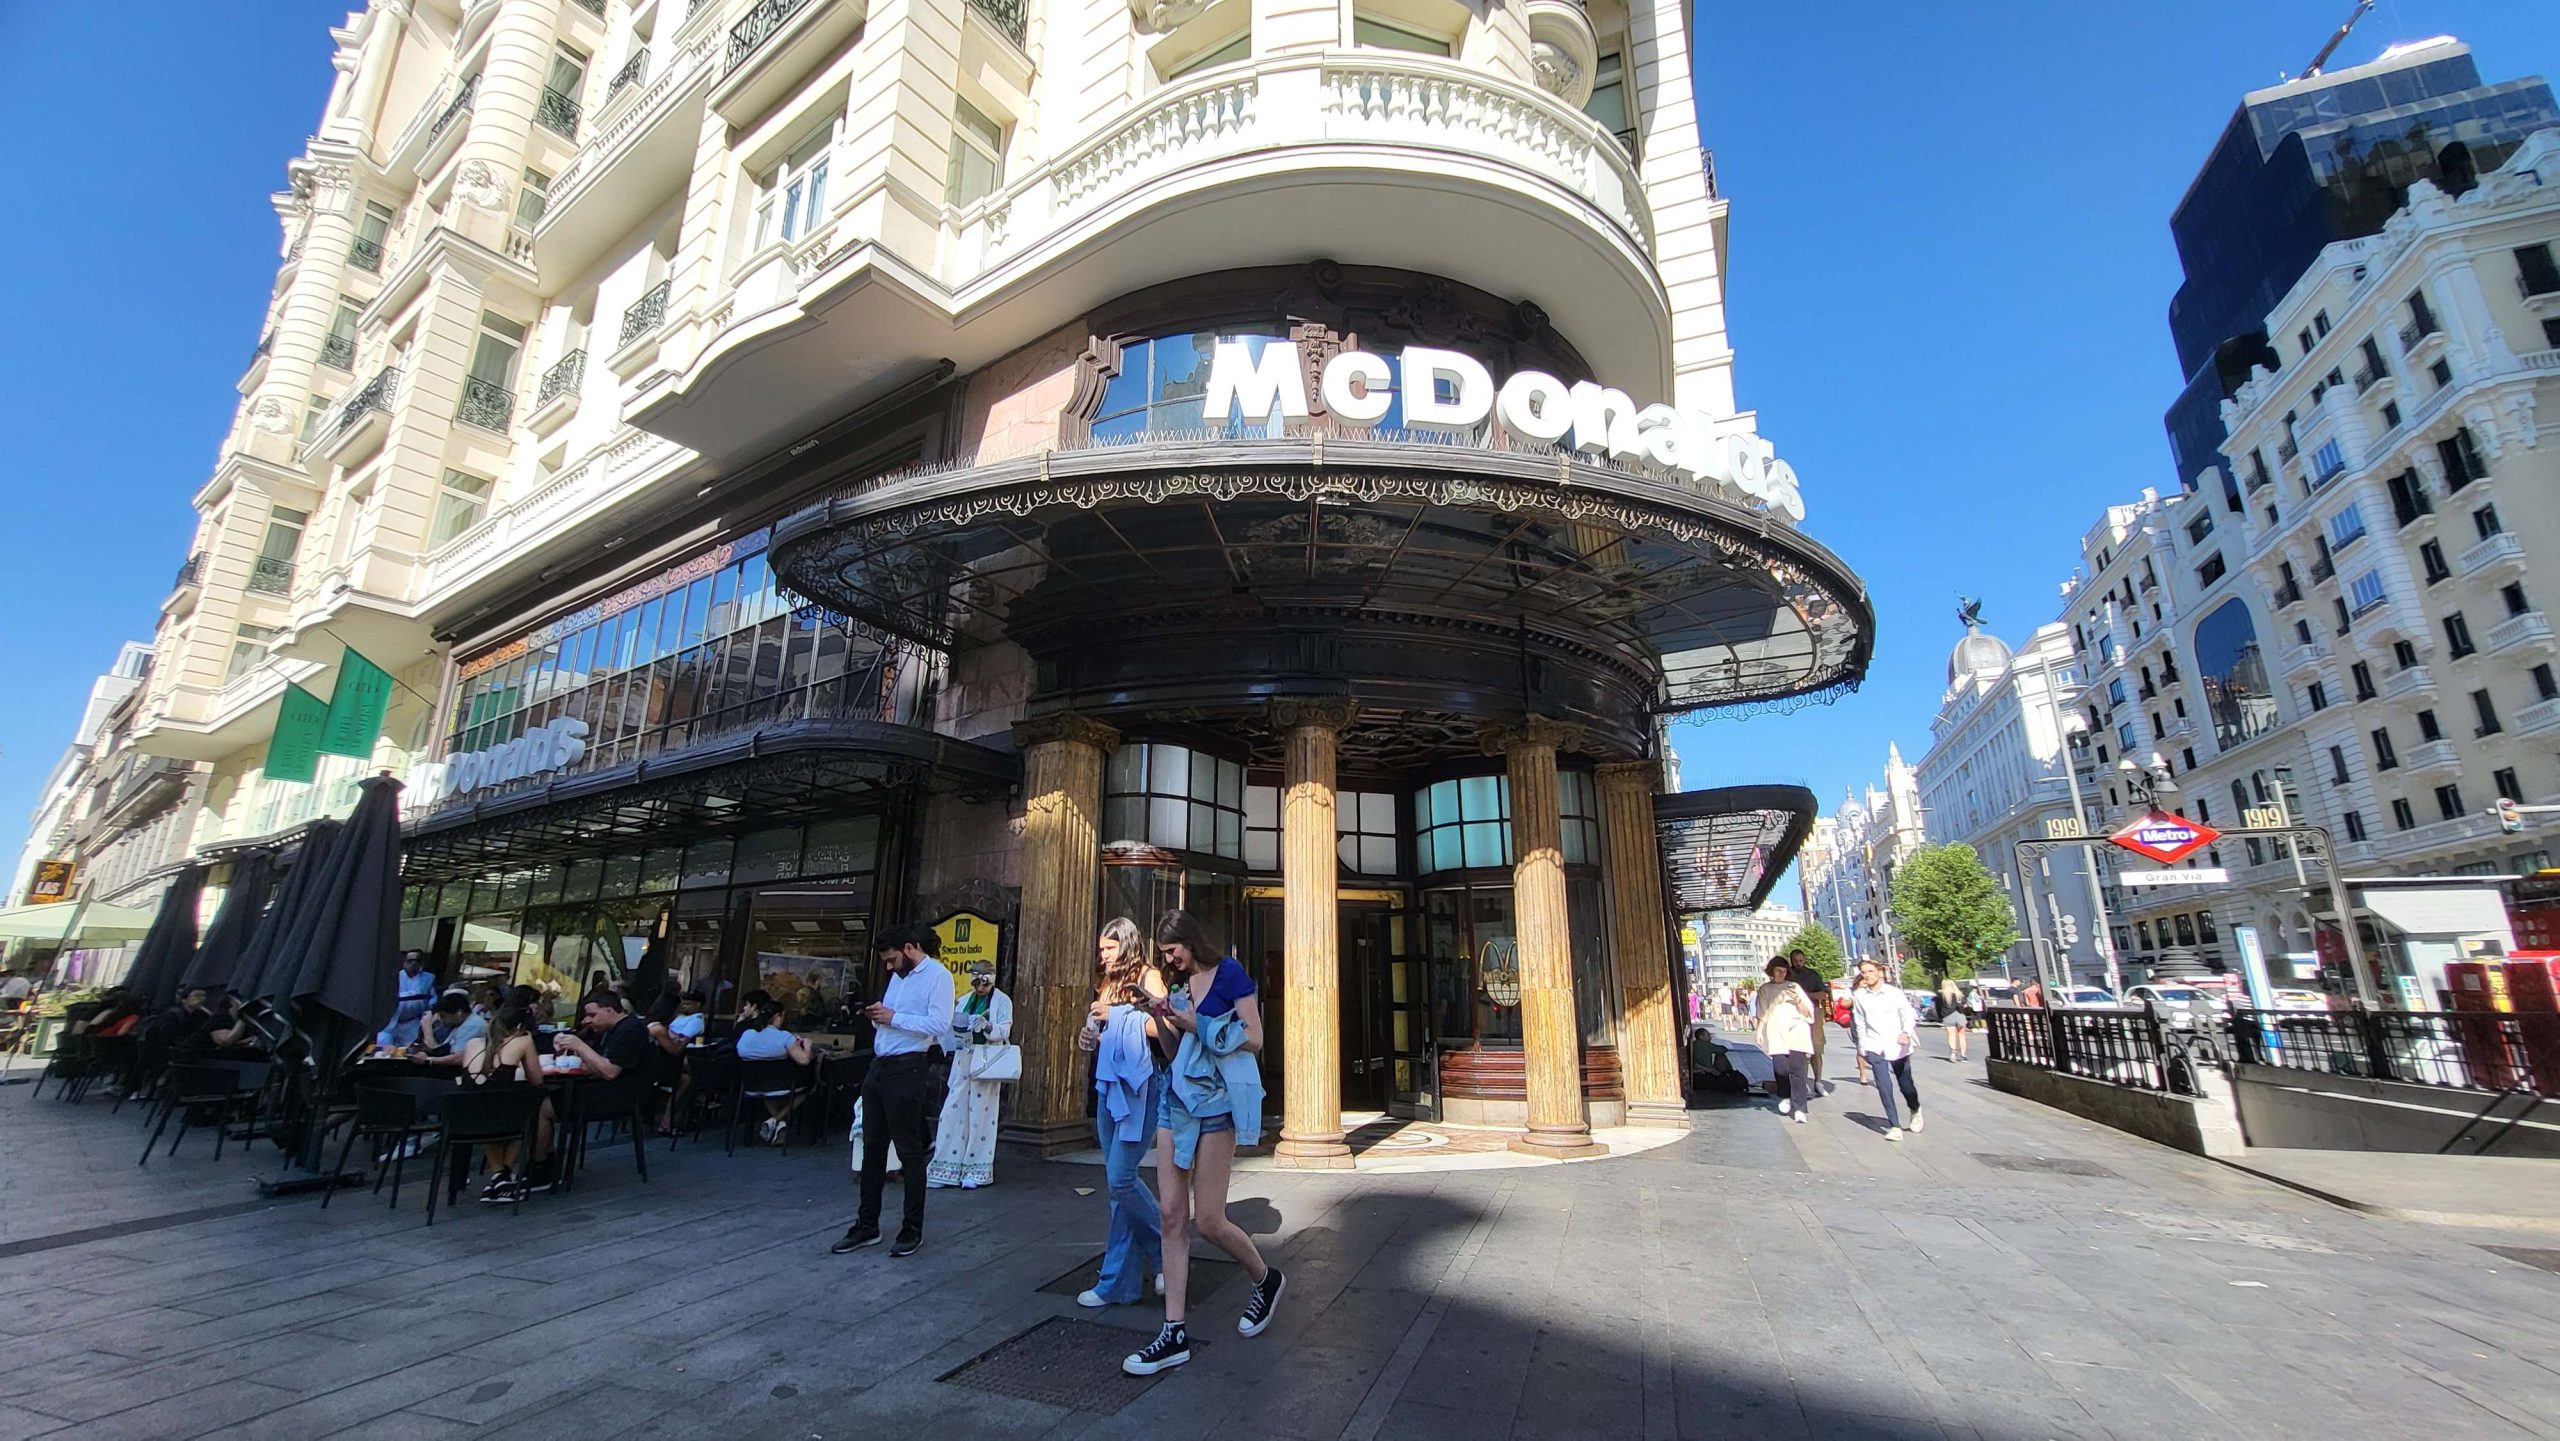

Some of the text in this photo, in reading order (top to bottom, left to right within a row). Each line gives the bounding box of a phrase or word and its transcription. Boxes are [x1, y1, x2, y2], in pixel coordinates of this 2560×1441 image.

[2244, 807, 2282, 828] 1919
[2045, 817, 2082, 838] 1919
[2142, 828, 2191, 843] Metro
[2145, 873, 2177, 882] Gran
[959, 945, 967, 954] tu
